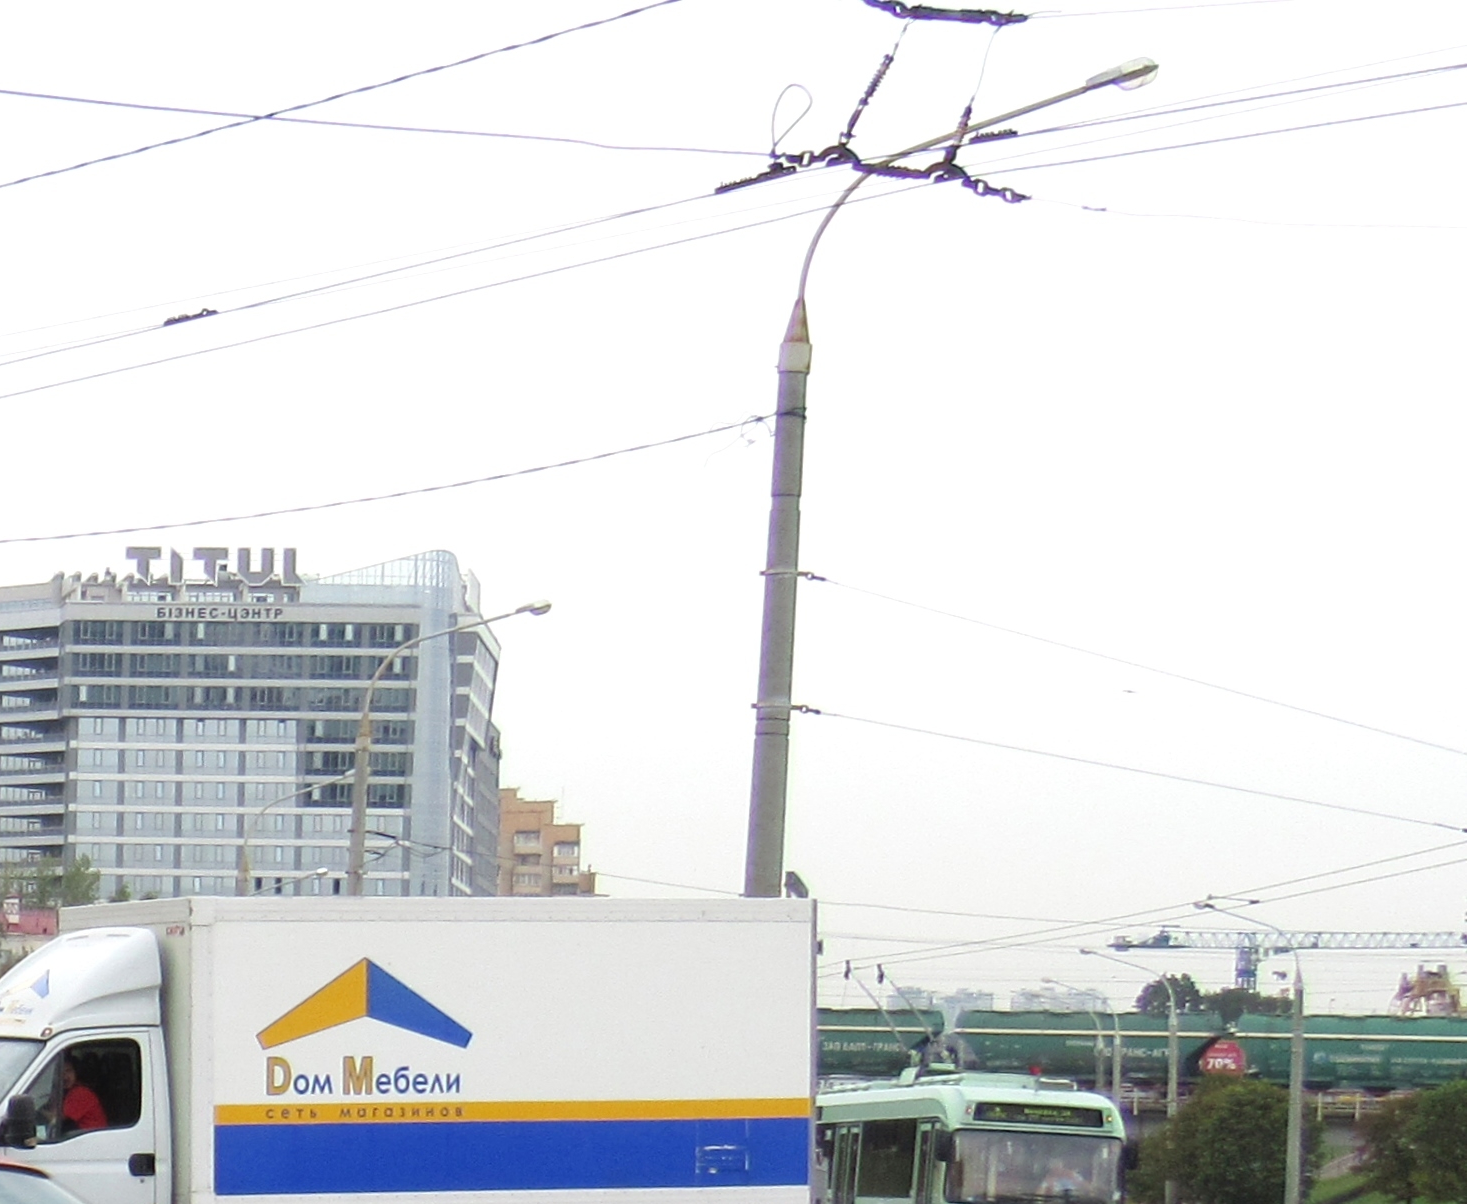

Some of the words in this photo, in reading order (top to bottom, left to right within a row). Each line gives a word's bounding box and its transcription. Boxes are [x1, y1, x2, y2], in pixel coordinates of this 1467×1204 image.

[125, 546, 307, 587] TITUL
[157, 606, 284, 621] БІЗНЕС-ЦЭНТР
[1206, 1058, 1237, 1070] 70%
[342, 1056, 461, 1096] Мебели
[265, 1107, 318, 1120] сеть
[339, 1106, 464, 1119] магазинов
